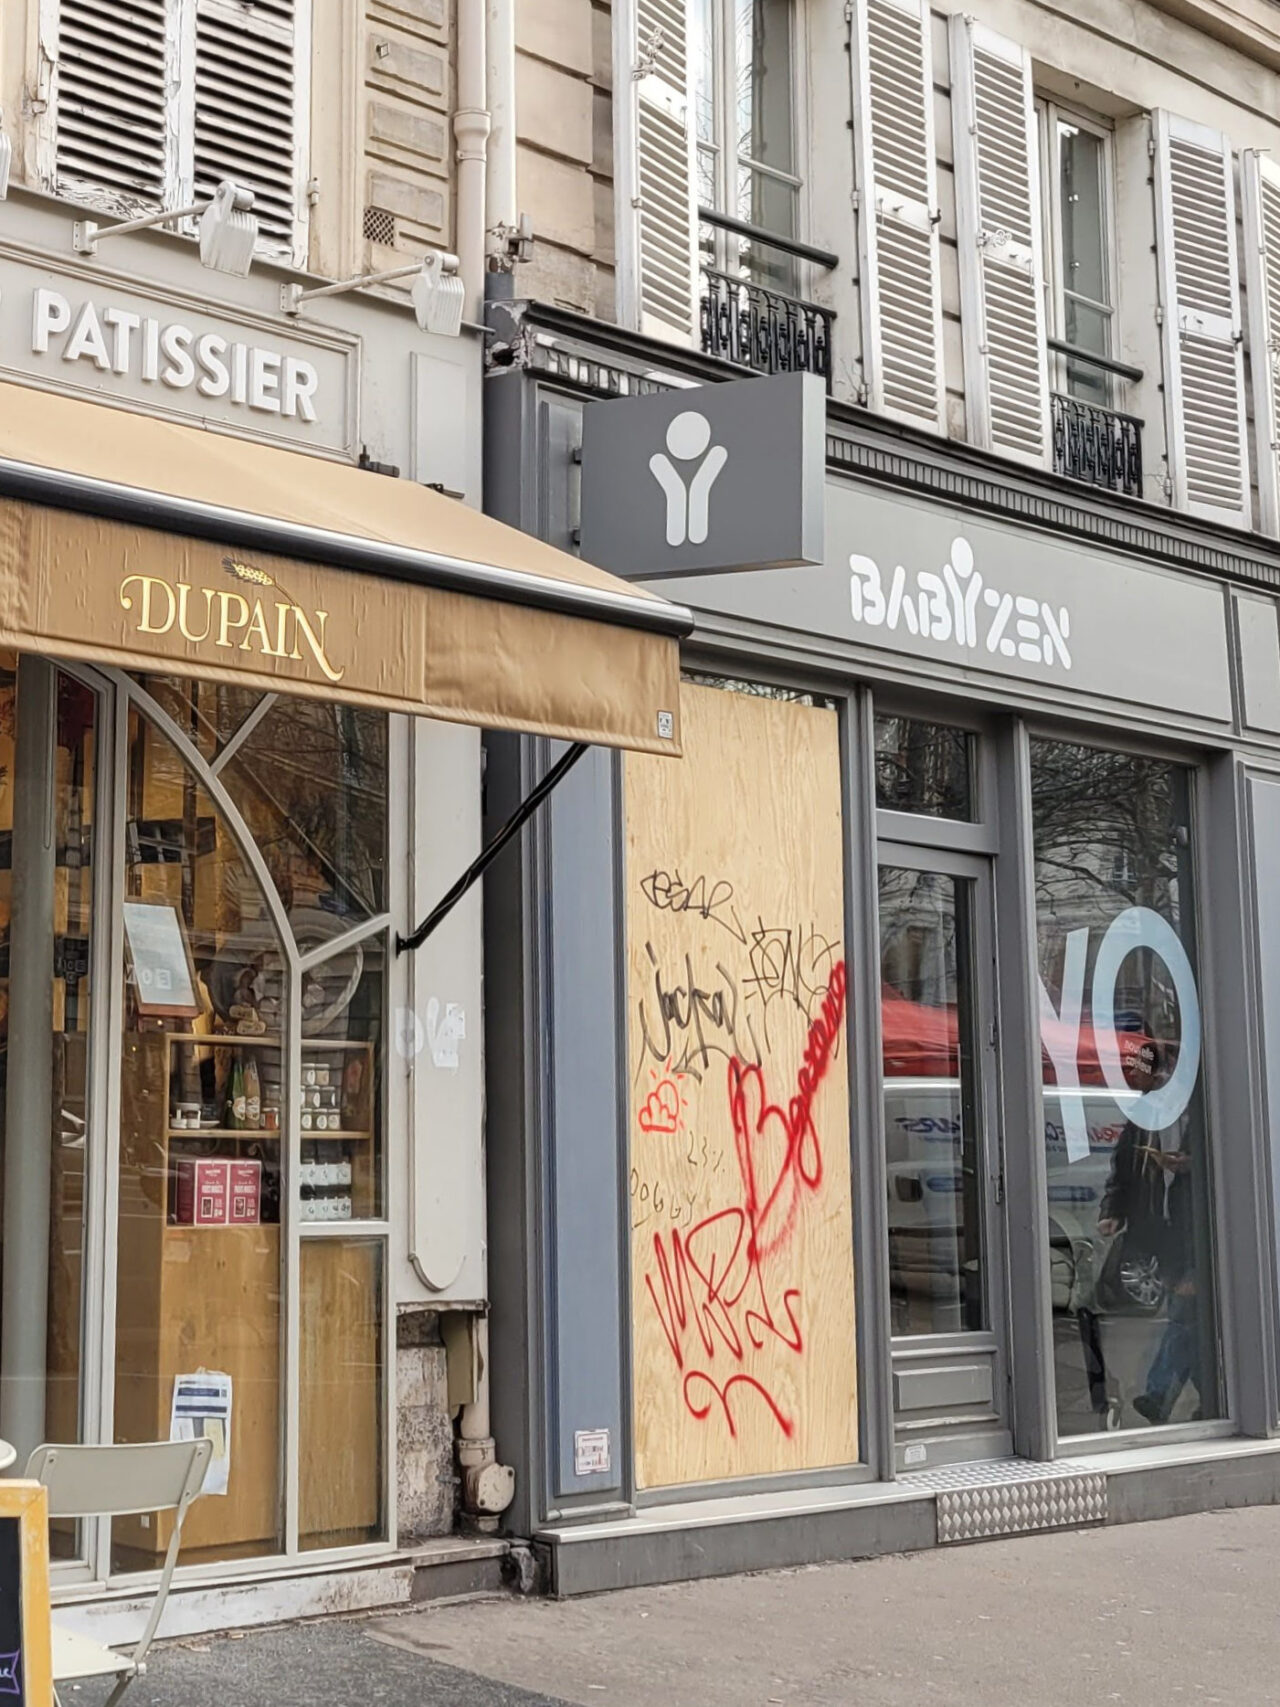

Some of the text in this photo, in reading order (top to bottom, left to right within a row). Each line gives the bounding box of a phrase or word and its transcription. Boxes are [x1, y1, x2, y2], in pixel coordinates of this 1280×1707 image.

[32, 287, 319, 423] PATISSIER
[119, 574, 346, 682] DUPAIN
[849, 537, 1072, 670] BABYZEN
